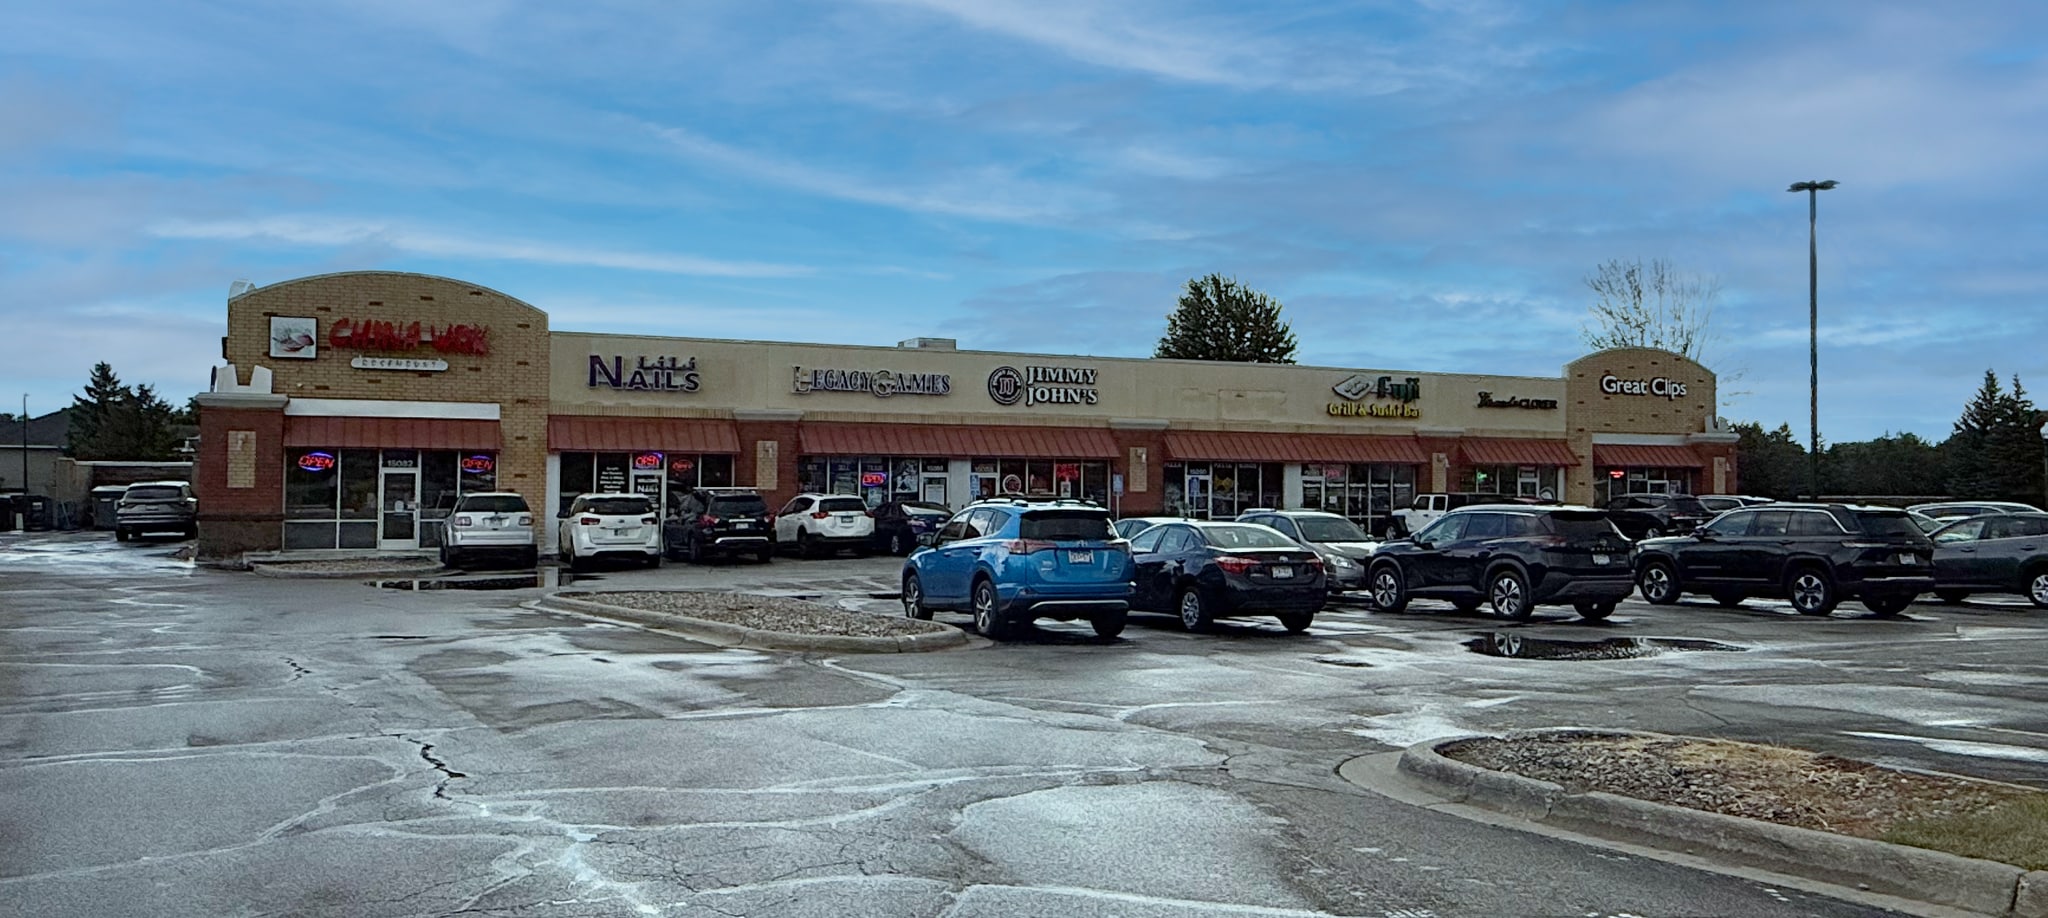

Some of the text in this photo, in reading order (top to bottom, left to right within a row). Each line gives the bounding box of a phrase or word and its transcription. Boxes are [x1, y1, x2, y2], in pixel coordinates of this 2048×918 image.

[328, 317, 421, 349] CHINA
[588, 354, 701, 392] NAILS
[1026, 366, 1098, 385] JIMMY
[872, 370, 951, 396] GAMES
[1602, 375, 1687, 399] Great Clips
[1026, 387, 1098, 406] JOHN'S
[1328, 402, 1356, 416] Grill
[1370, 403, 1401, 416] Sushi
[298, 454, 335, 468] OPEN
[461, 457, 495, 470] OPEN
